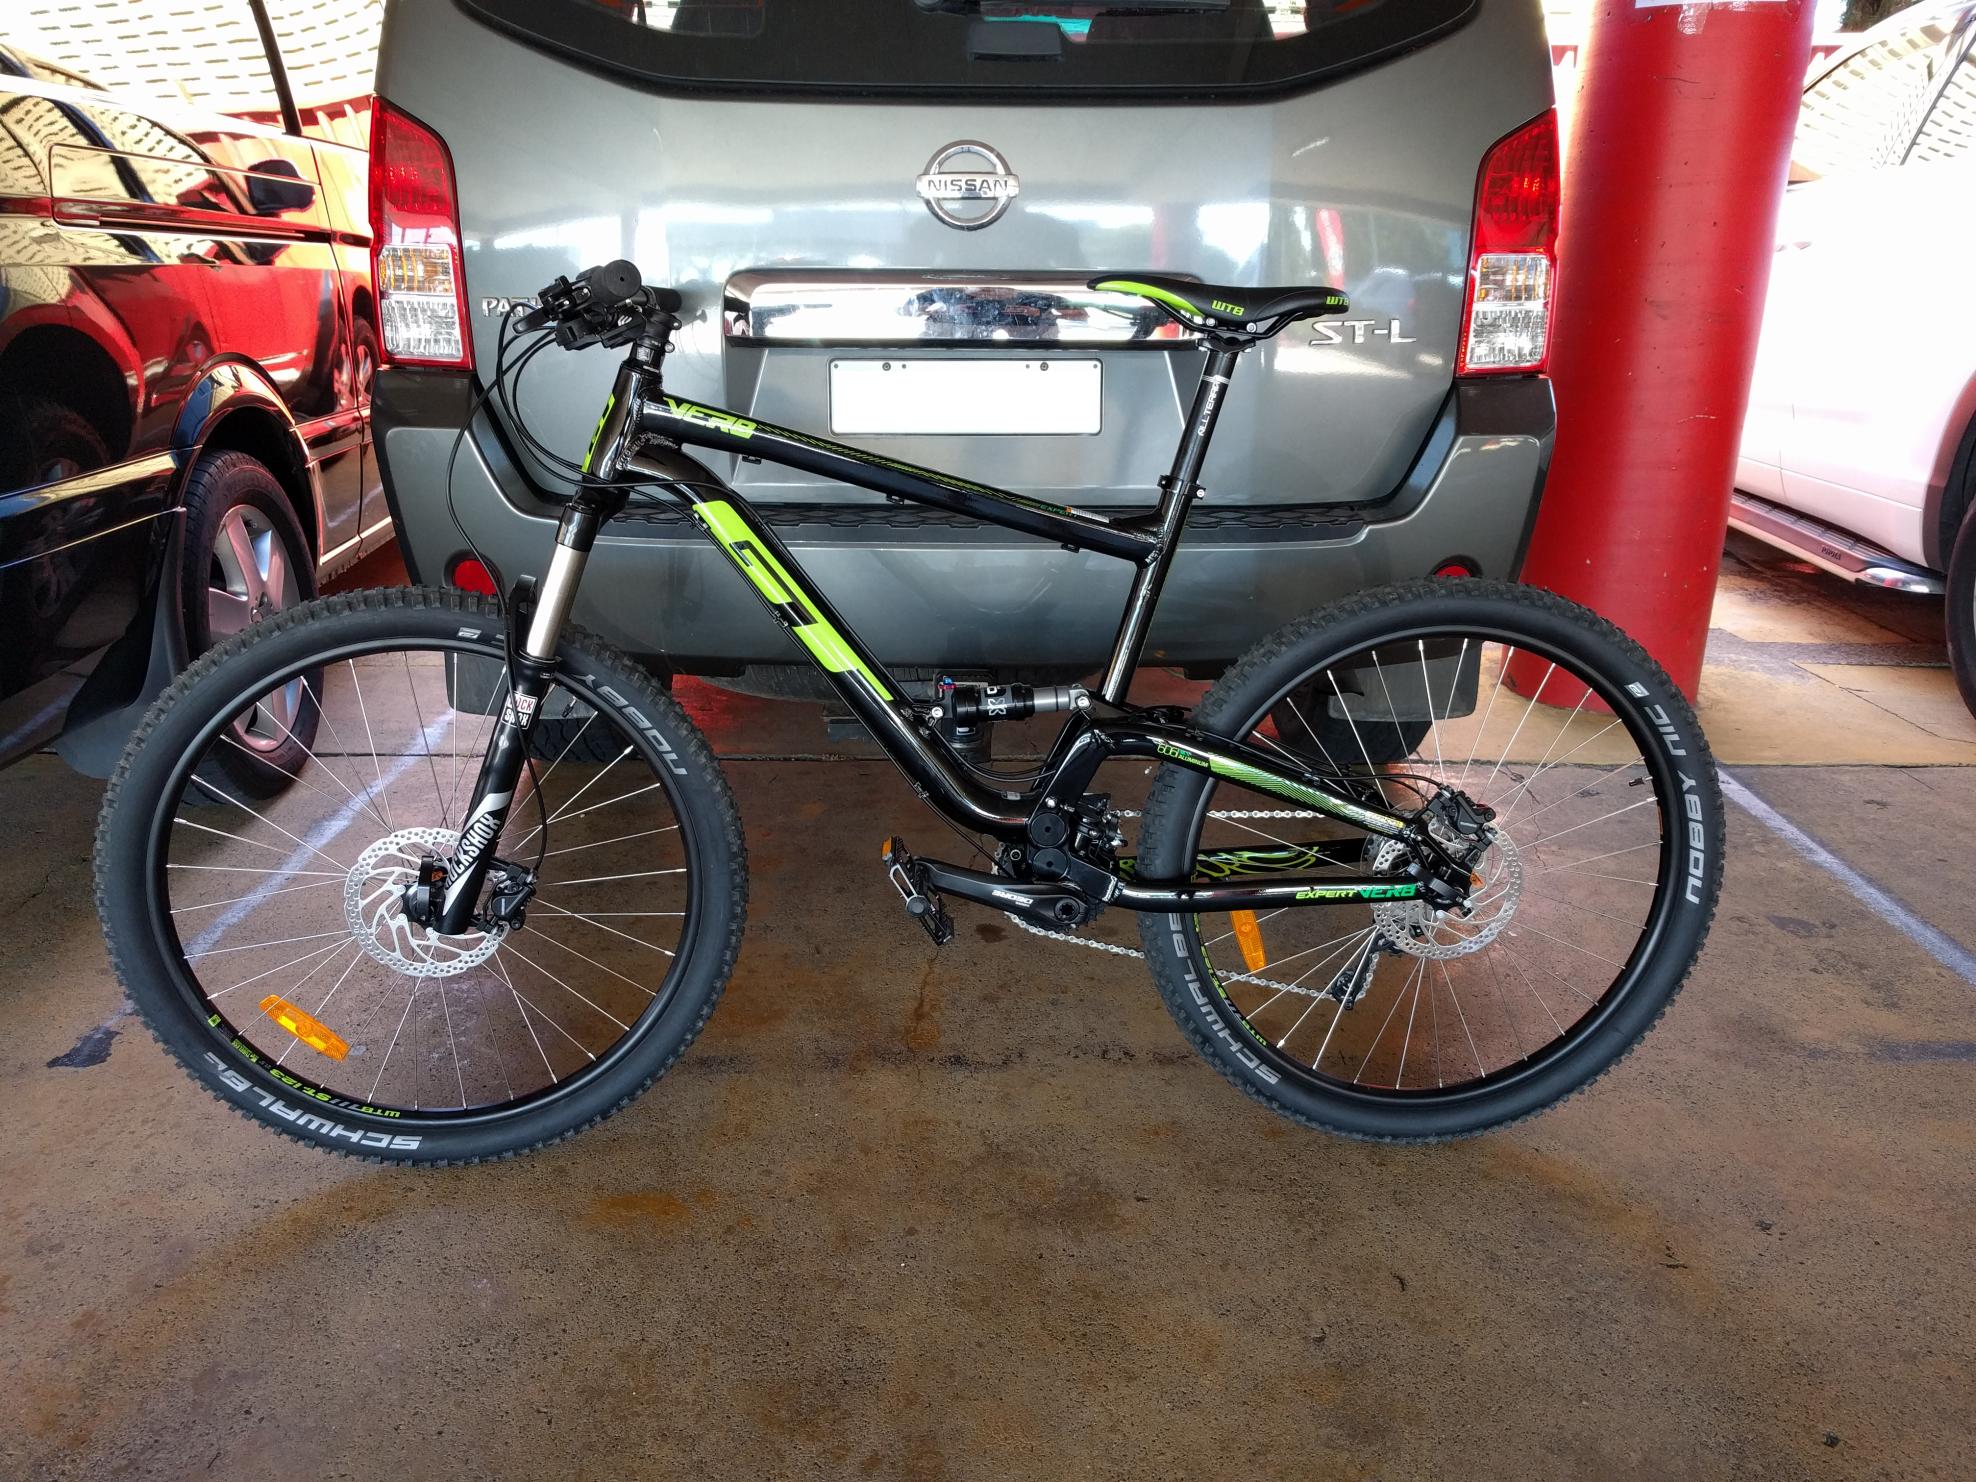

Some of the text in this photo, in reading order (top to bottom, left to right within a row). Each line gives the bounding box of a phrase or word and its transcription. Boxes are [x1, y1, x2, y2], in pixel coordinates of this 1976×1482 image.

[927, 178, 1008, 192] NISSAN
[1211, 299, 1245, 316] WTB
[1309, 318, 1417, 345] ST-L
[573, 673, 688, 776] NOBBY
[1645, 704, 1706, 905] NOBBY NIC
[1295, 883, 1418, 900] EXPERT VERB
[1168, 912, 1283, 1085] SCHWALBE
[360, 1104, 401, 1118] WTB
